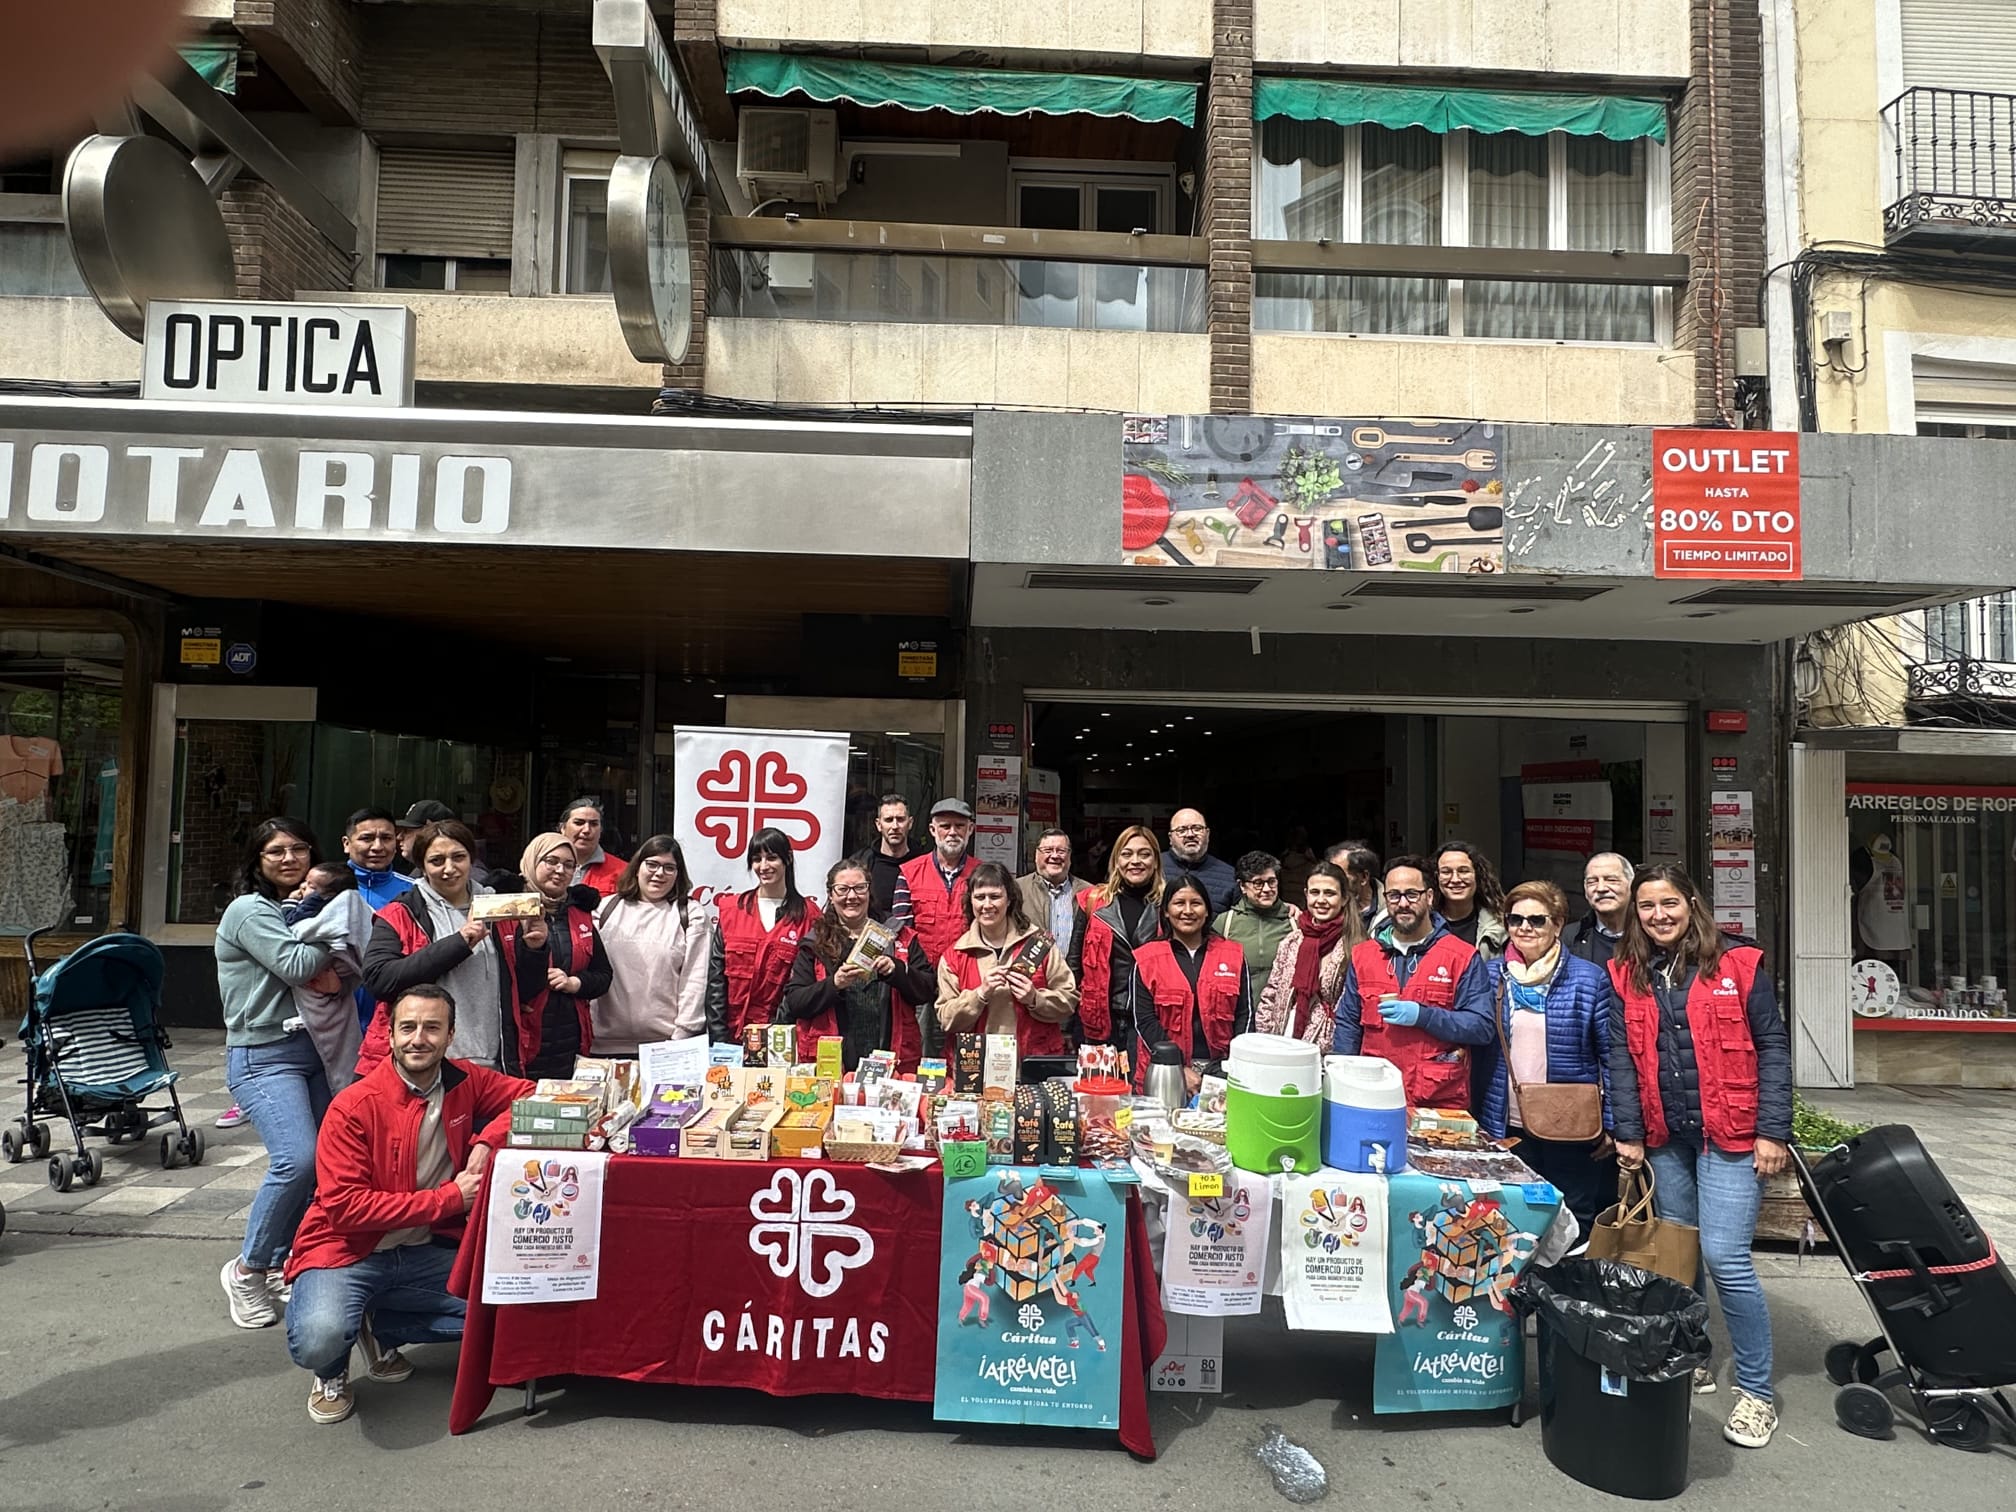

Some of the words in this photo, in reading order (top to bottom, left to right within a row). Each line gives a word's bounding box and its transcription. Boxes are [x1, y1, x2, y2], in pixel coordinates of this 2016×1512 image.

[163, 313, 382, 396] OPTICA
[1662, 448, 1790, 473] OUTLET
[0, 441, 513, 534] OTARIO
[1705, 487, 1749, 498] HASTA
[1660, 509, 1723, 532] 80%
[1732, 510, 1795, 533] DTO
[1673, 550, 1722, 561] TIEMPO
[1725, 551, 1788, 562] LIMITADO
[232, 653, 252, 662] ADT
[1849, 795, 1948, 811] ARREGLOS
[1953, 797, 1977, 811] DE
[1891, 815, 1976, 824] PERSONALIZADOS
[1906, 1008, 1989, 1019] BORDADOS
[513, 1235, 550, 1244] COMERCIO
[551, 1235, 574, 1244] JUSTO
[1189, 1251, 1223, 1260] COMERCIO
[1225, 1253, 1244, 1261] JUSTO
[1326, 1257, 1355, 1265] PRODUCTO
[1305, 1264, 1341, 1274] COMERCIO
[1343, 1265, 1364, 1275] JUSTO
[702, 1300, 890, 1364] CÁRITAS
[1436, 1330, 1490, 1344] Cáritas
[1001, 1332, 1057, 1345] Cáritas
[1201, 1359, 1216, 1369] 80
[971, 1397, 1021, 1406] VOLUNTARIADO
[1023, 1399, 1049, 1407] MEJORA
[1062, 1402, 1093, 1410] ENTORNO
